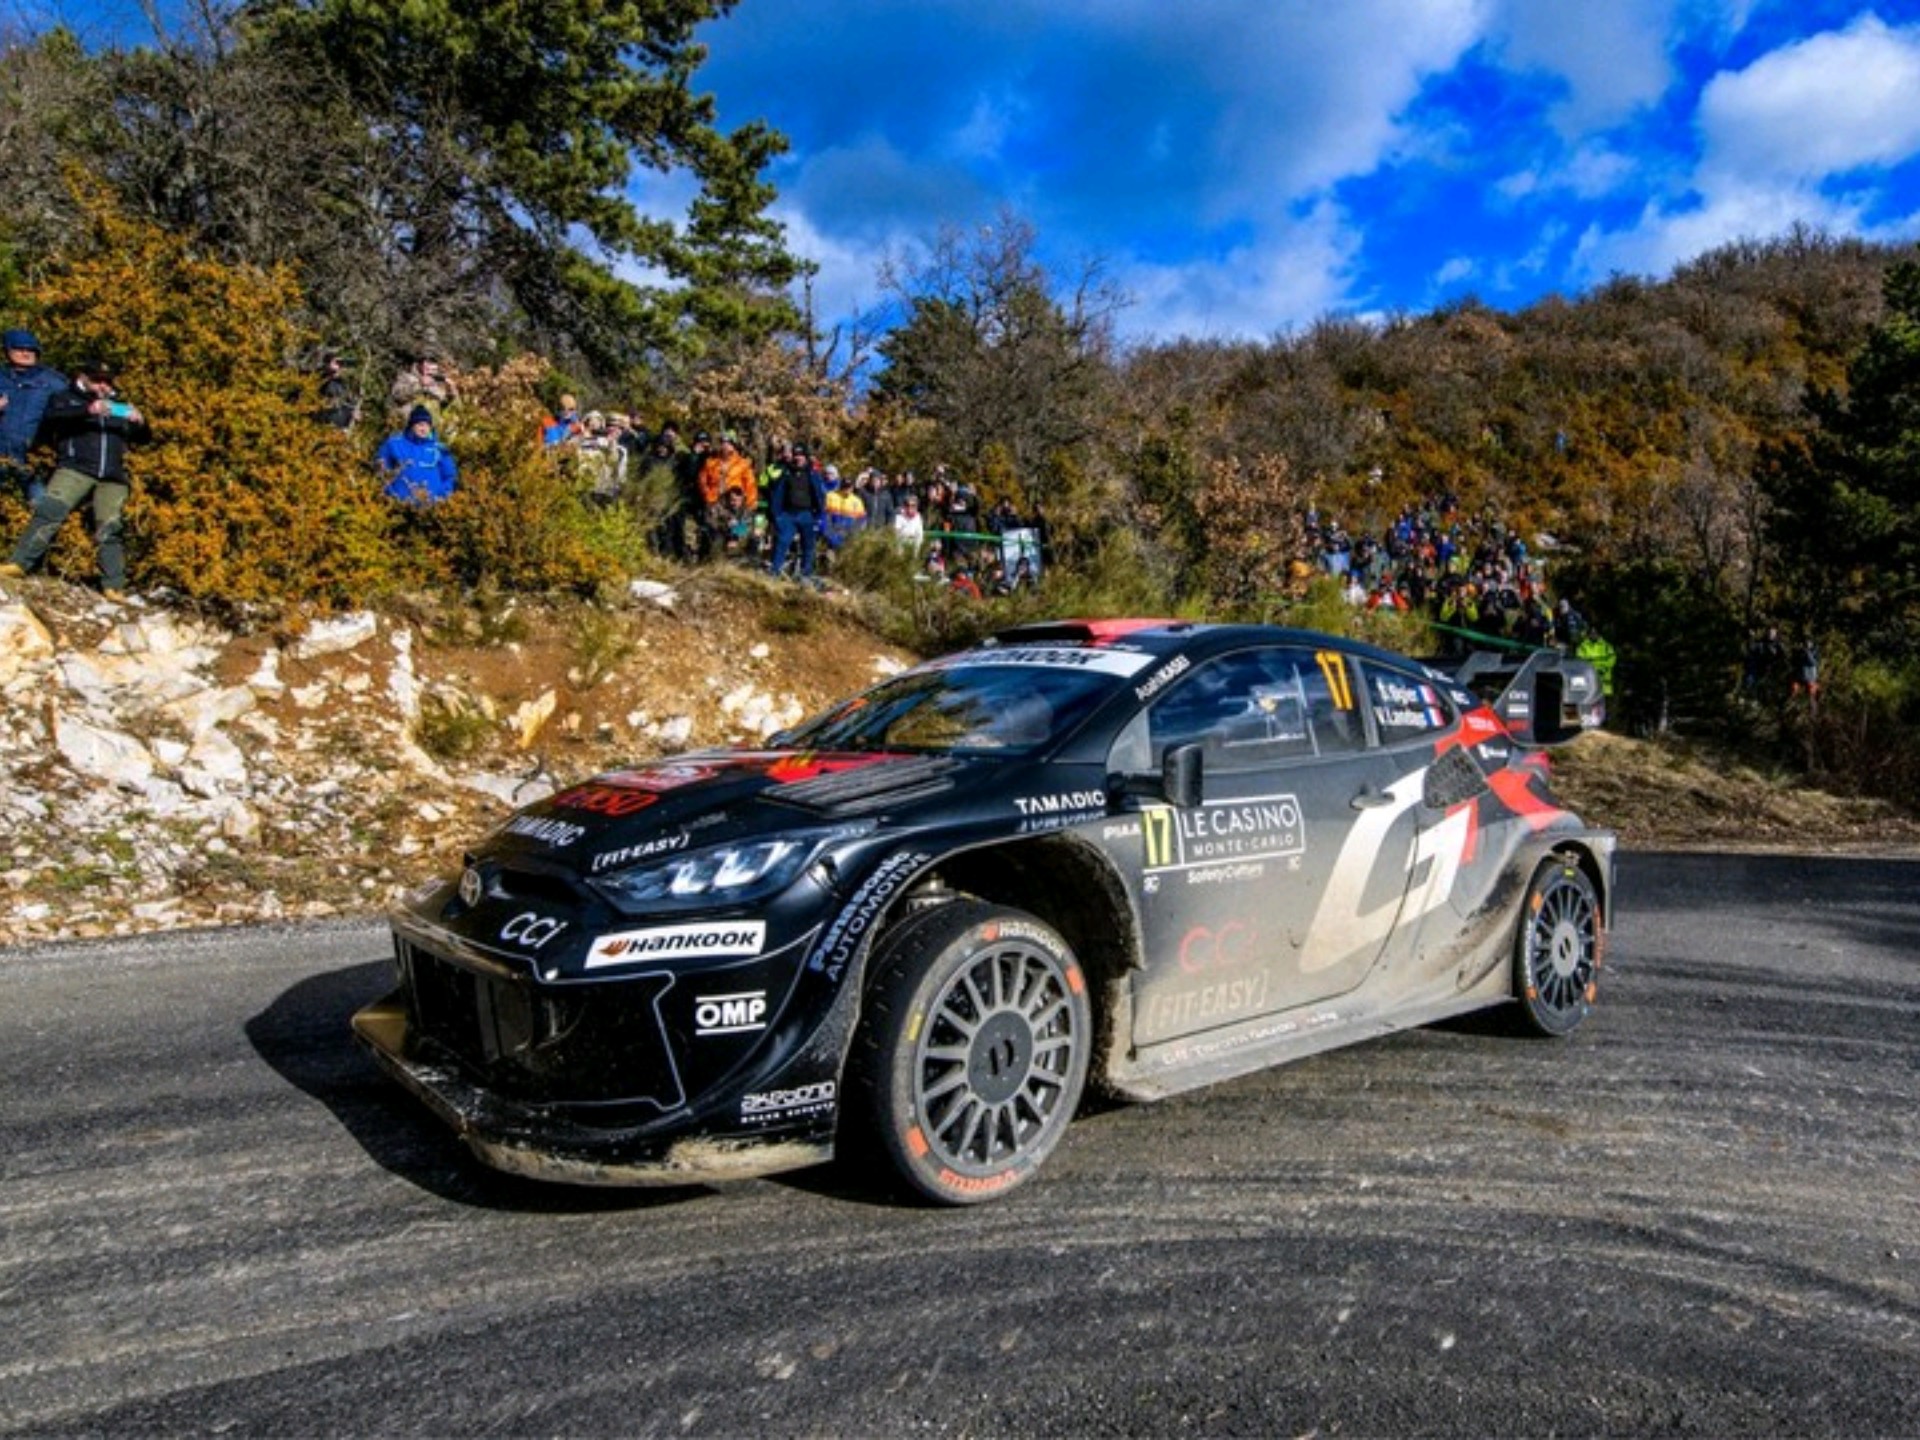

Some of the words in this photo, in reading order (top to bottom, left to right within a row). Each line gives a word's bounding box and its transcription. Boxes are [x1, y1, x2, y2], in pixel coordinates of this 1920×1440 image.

[1315, 650, 1353, 710] 17
[1014, 790, 1106, 815] TAMADIC
[1181, 810, 1208, 838] LE
[1211, 803, 1297, 836] CASINO
[1143, 808, 1173, 866] 17
[499, 911, 569, 949] CCI
[808, 851, 911, 973] Panasonic
[825, 852, 932, 983] AUTOMOTIVE
[695, 999, 767, 1027] OMP
